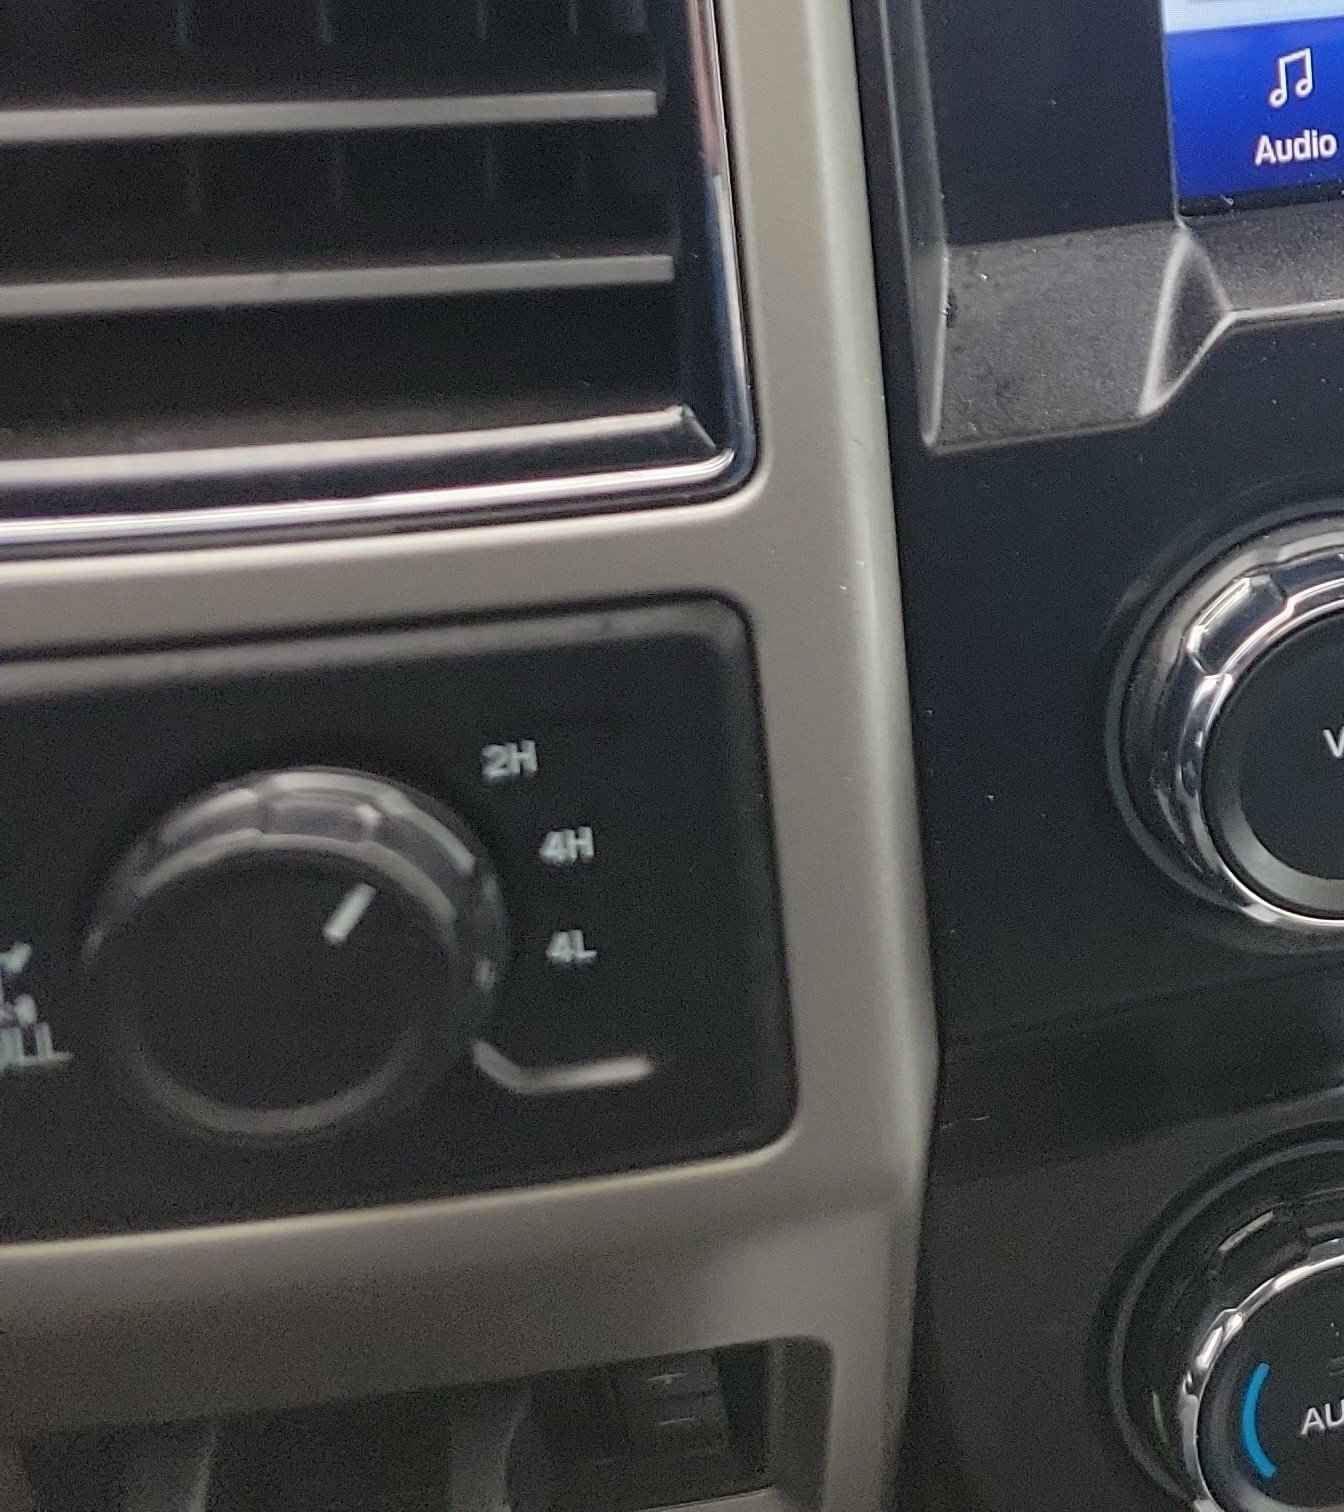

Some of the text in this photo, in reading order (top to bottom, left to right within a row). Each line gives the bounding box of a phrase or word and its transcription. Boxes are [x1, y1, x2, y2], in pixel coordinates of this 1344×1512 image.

[1254, 129, 1338, 165] Audio
[482, 740, 538, 781] 2H
[540, 827, 594, 865] 4H
[547, 930, 597, 965] 4L
